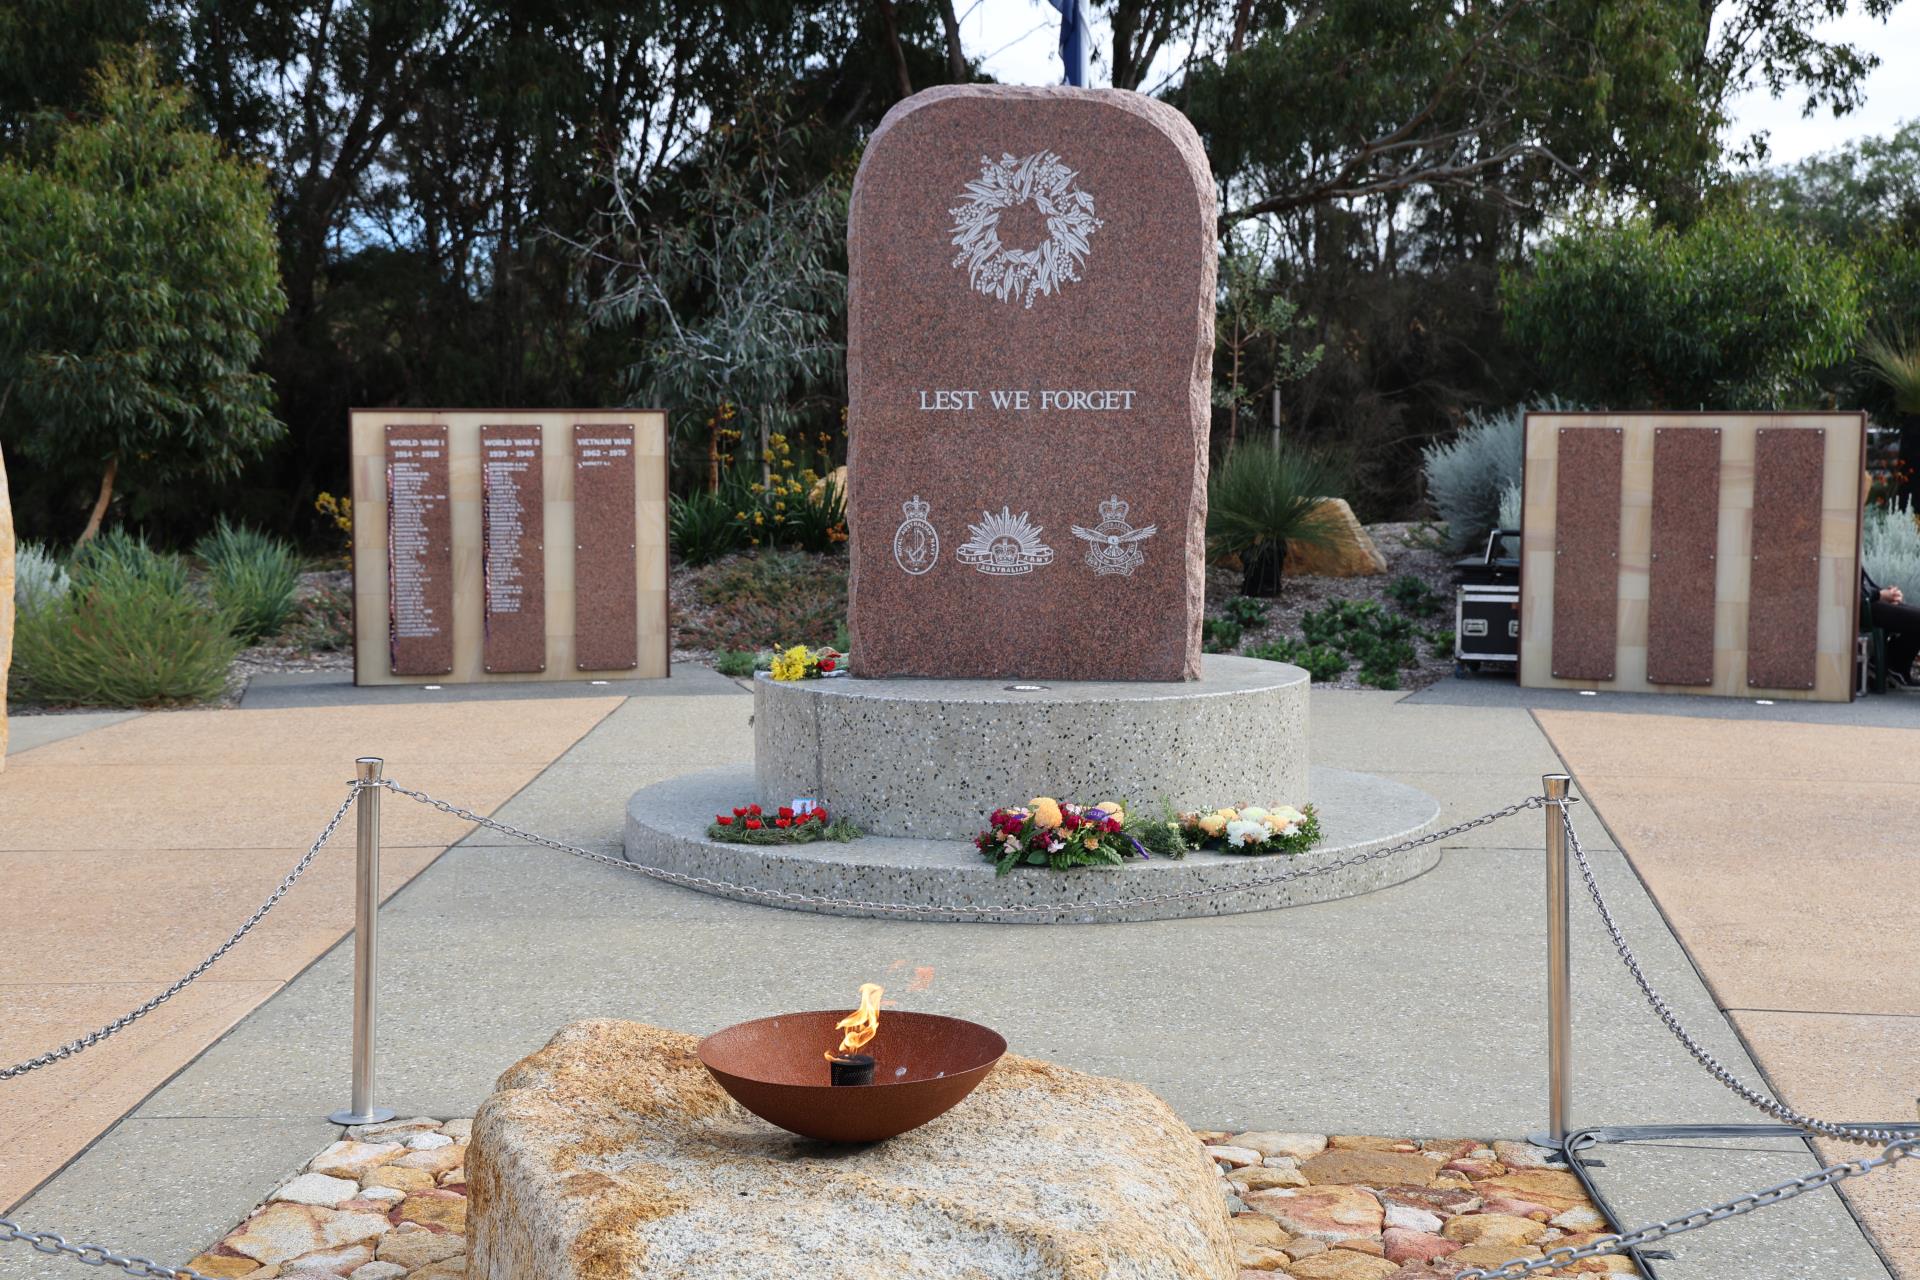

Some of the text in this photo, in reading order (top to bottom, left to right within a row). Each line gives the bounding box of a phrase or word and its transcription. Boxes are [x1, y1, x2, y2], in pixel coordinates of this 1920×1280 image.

[919, 390, 1136, 411] LEST WE FORGET
[390, 439, 419, 447] WORLD
[420, 439, 440, 447] WAR
[484, 439, 512, 447] WORLD
[513, 439, 533, 447] WAR
[576, 438, 632, 446] VIETNAM WAR
[583, 449, 601, 457] 1962
[609, 449, 627, 457] 1975
[980, 564, 1029, 573] AUSTRALIAN
